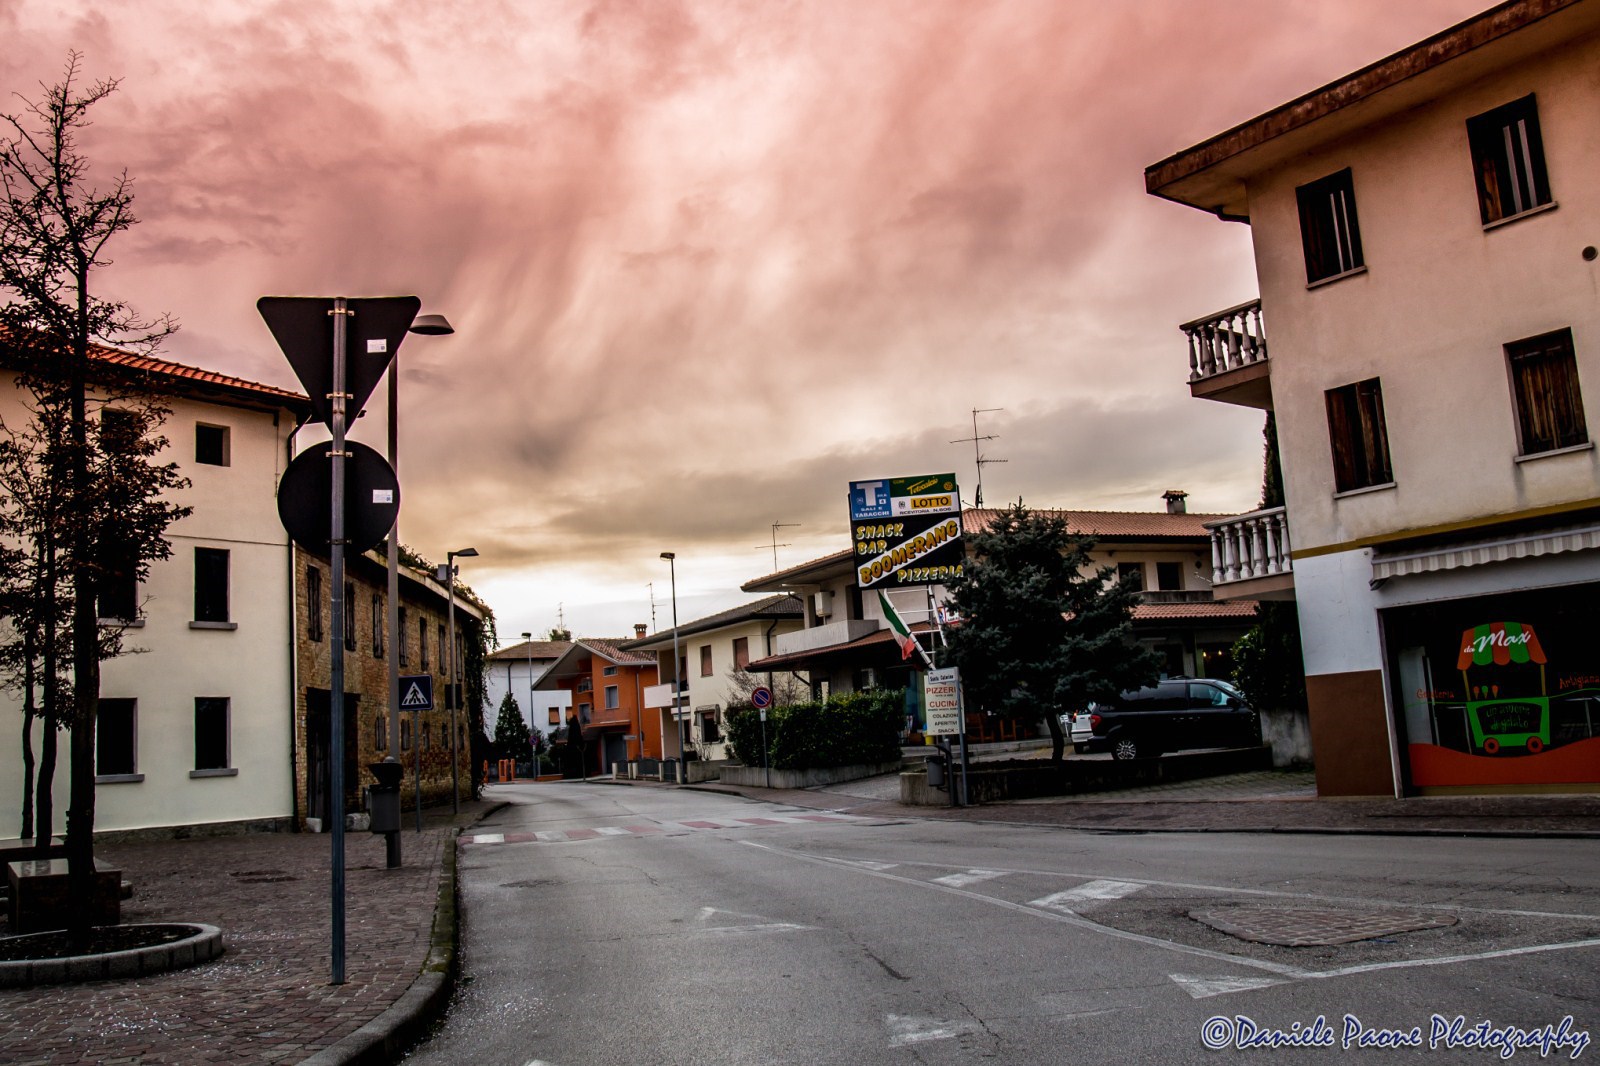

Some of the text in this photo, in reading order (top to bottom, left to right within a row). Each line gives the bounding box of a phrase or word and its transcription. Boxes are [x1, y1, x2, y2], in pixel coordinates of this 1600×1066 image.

[856, 481, 883, 507] T
[912, 496, 950, 508] LOTTO
[856, 522, 904, 540] SNACK
[857, 540, 888, 555] BAR
[860, 520, 958, 584] BOOMERANG
[897, 564, 964, 583] PIZZERIA
[1463, 629, 1531, 653] da Max
